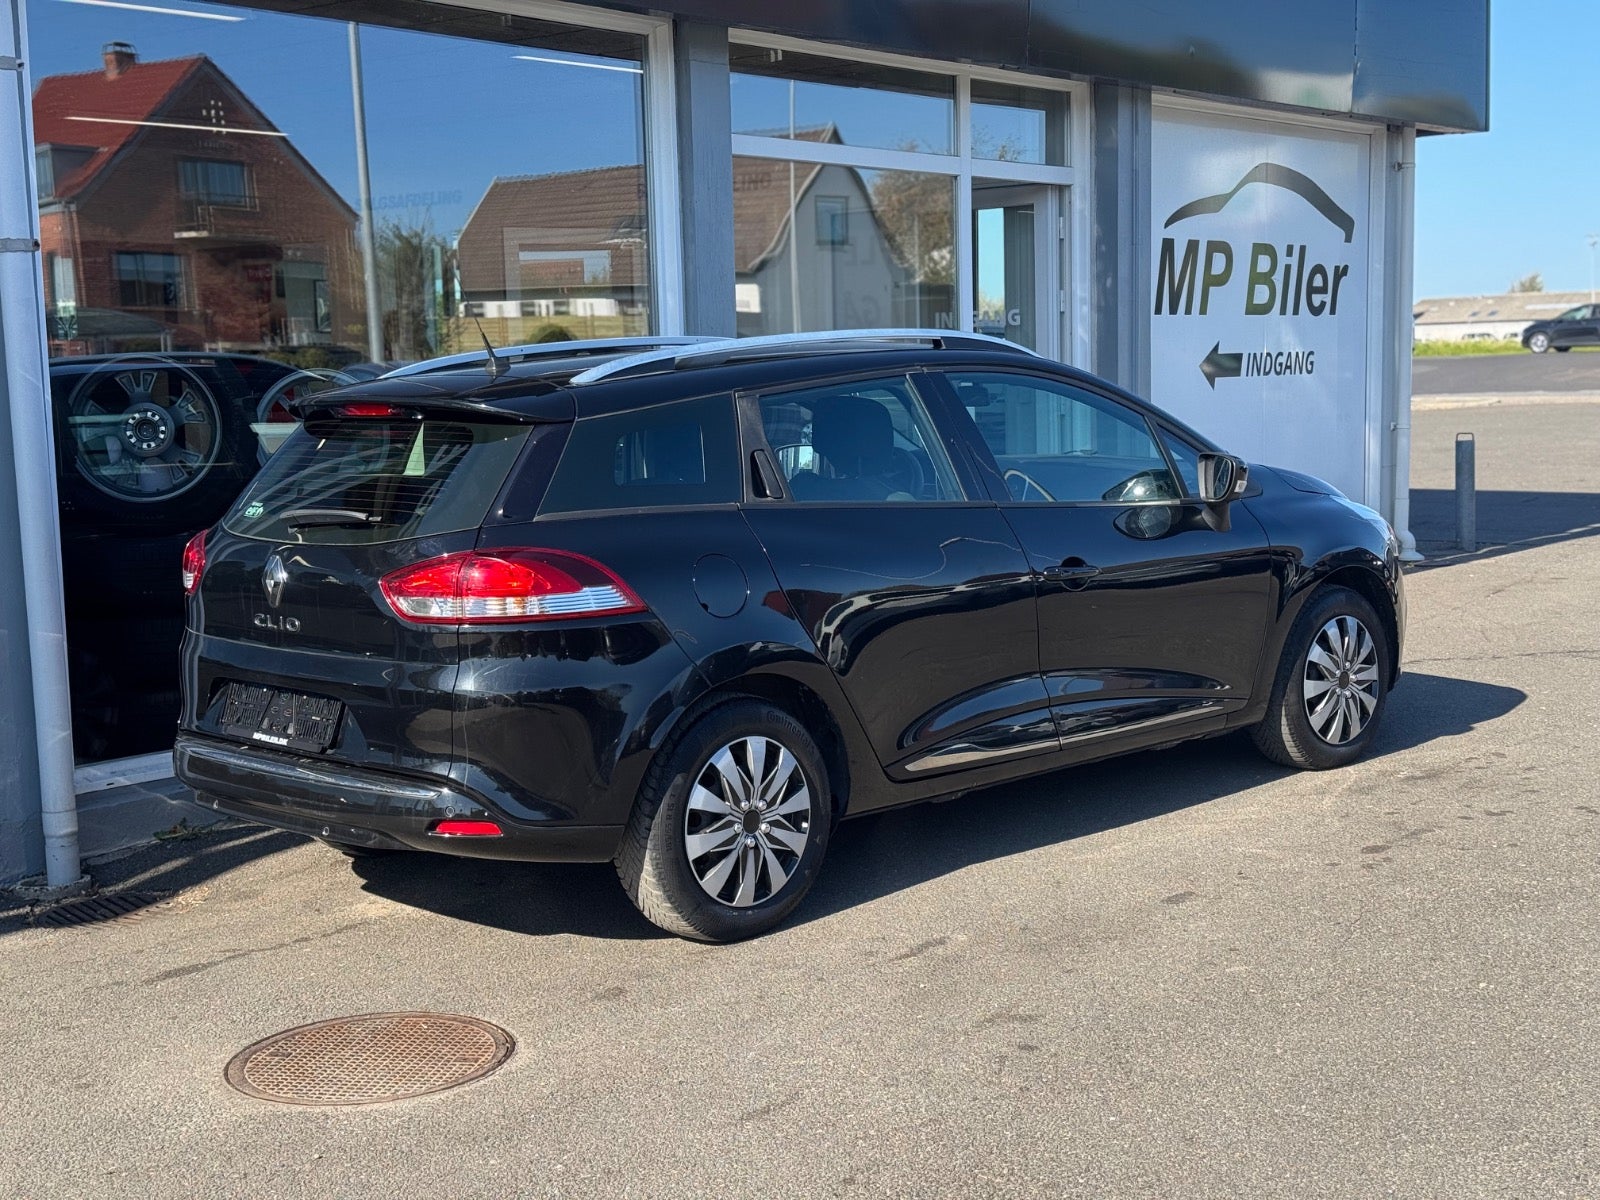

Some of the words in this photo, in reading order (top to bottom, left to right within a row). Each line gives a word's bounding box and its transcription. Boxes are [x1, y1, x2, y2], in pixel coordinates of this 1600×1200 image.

[1154, 237, 1233, 316] MP
[1245, 242, 1349, 317] Biler
[1245, 350, 1315, 377] INDGANG
[254, 613, 301, 632] CLIO
